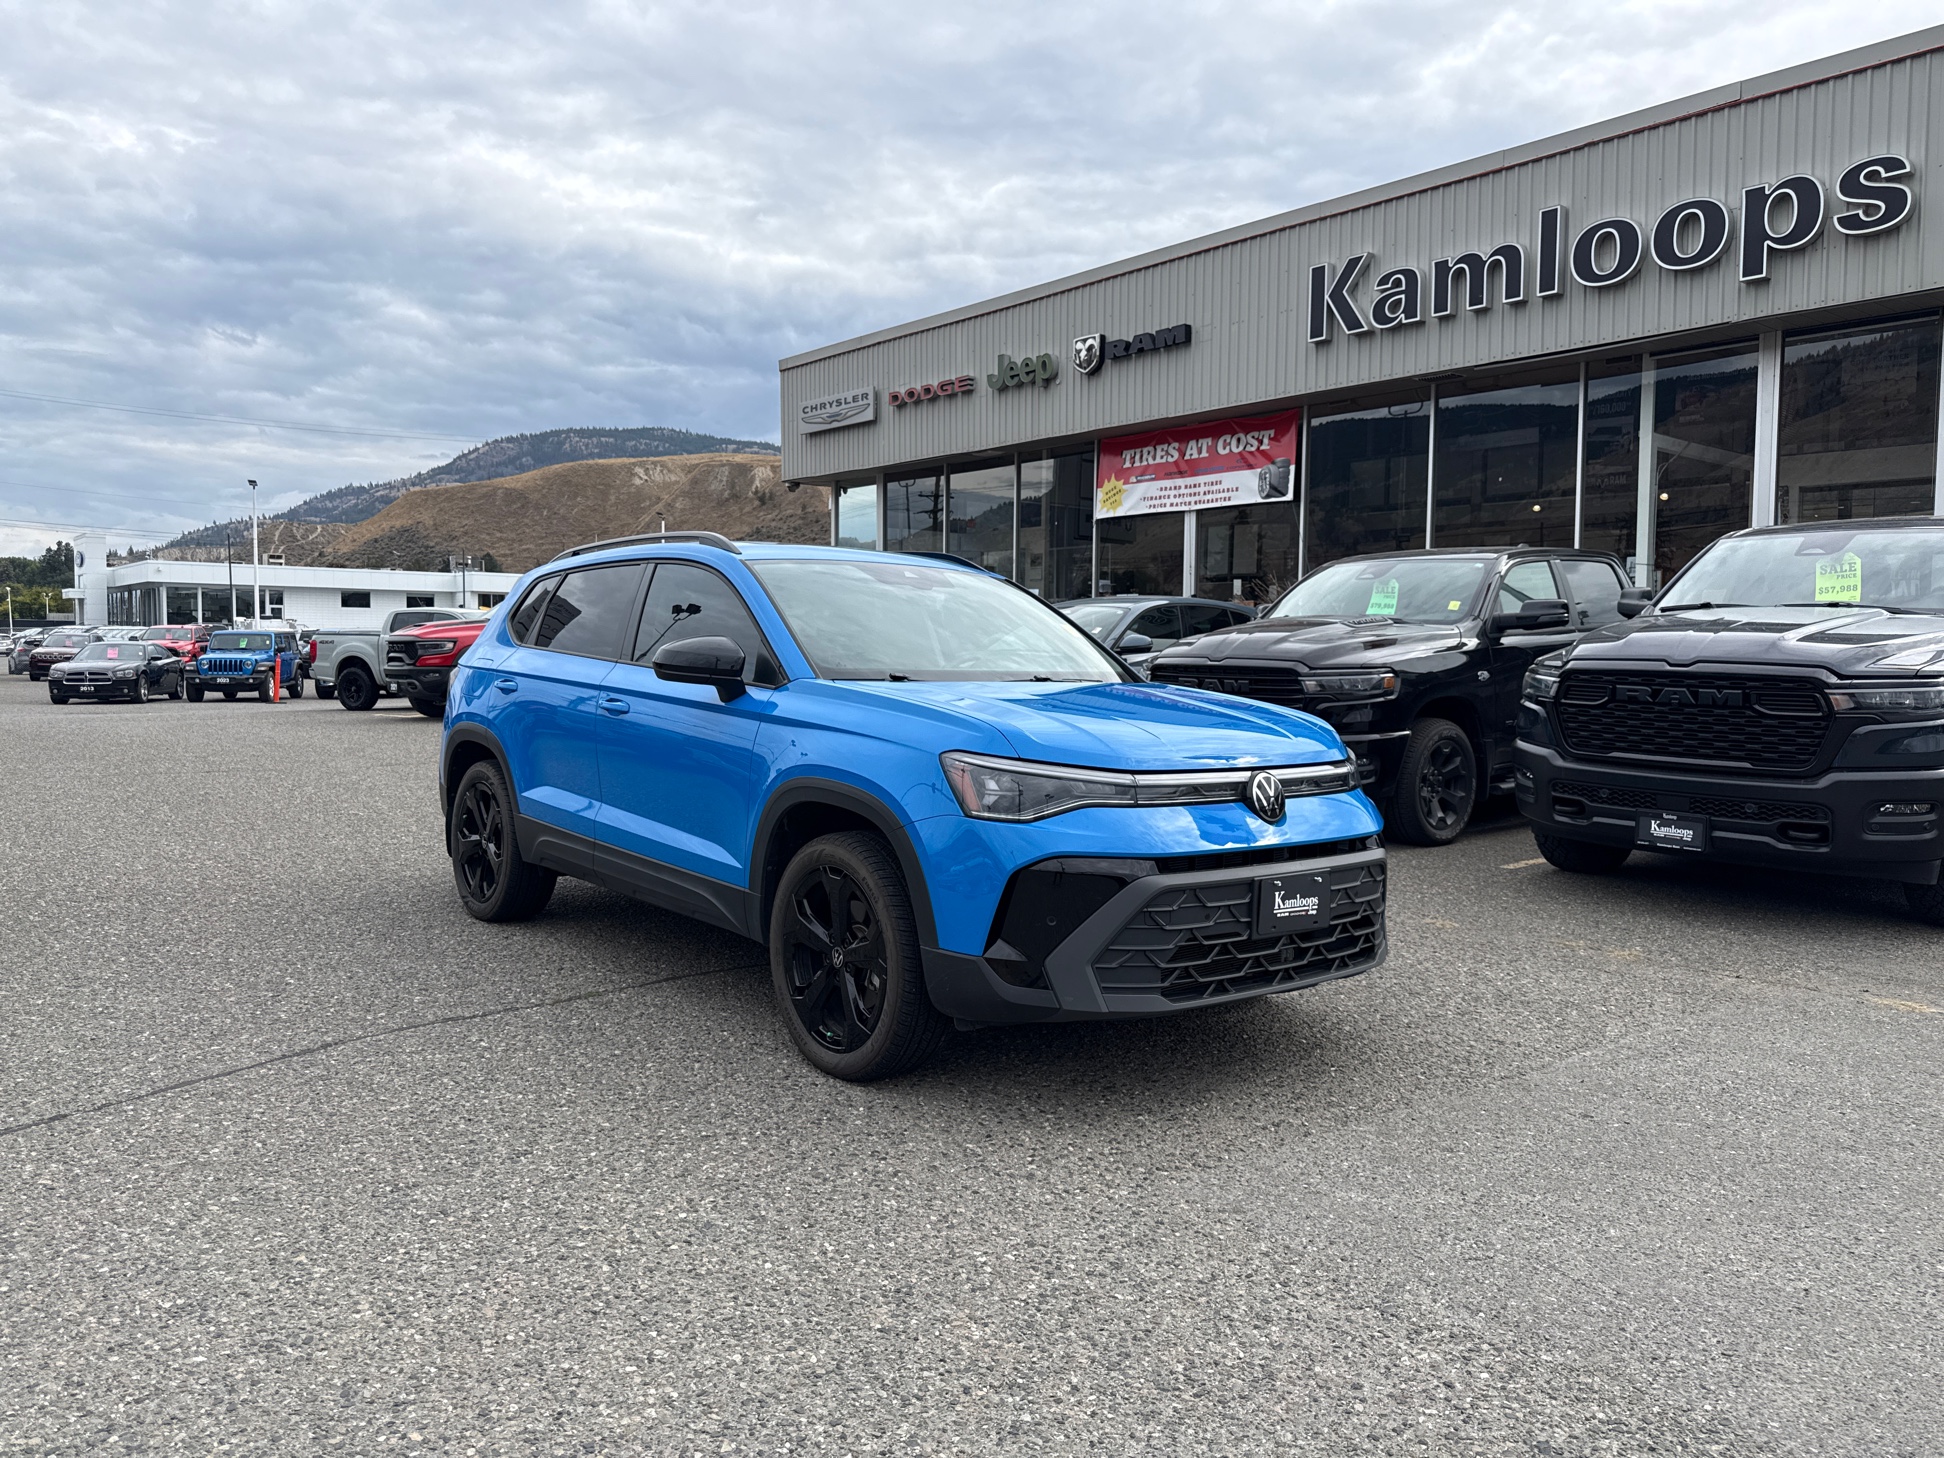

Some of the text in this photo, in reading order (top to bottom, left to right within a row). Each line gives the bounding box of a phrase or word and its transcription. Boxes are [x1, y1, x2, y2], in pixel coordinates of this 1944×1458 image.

[1308, 154, 1914, 343] Kamloops
[1106, 323, 1191, 360] RAM
[987, 353, 1058, 391] Jeep
[888, 375, 976, 407] DODGE
[802, 392, 869, 414] CHRYSLER
[1121, 429, 1275, 468] TIRES AT COST
[1819, 562, 1857, 575] SALE
[1375, 586, 1396, 594] SALE
[1818, 584, 1858, 595] $57,988
[1178, 677, 1250, 692] RAM
[1616, 685, 1742, 706] RAM
[1650, 820, 1693, 838] Kamloops
[1274, 890, 1318, 910] Kamloops
